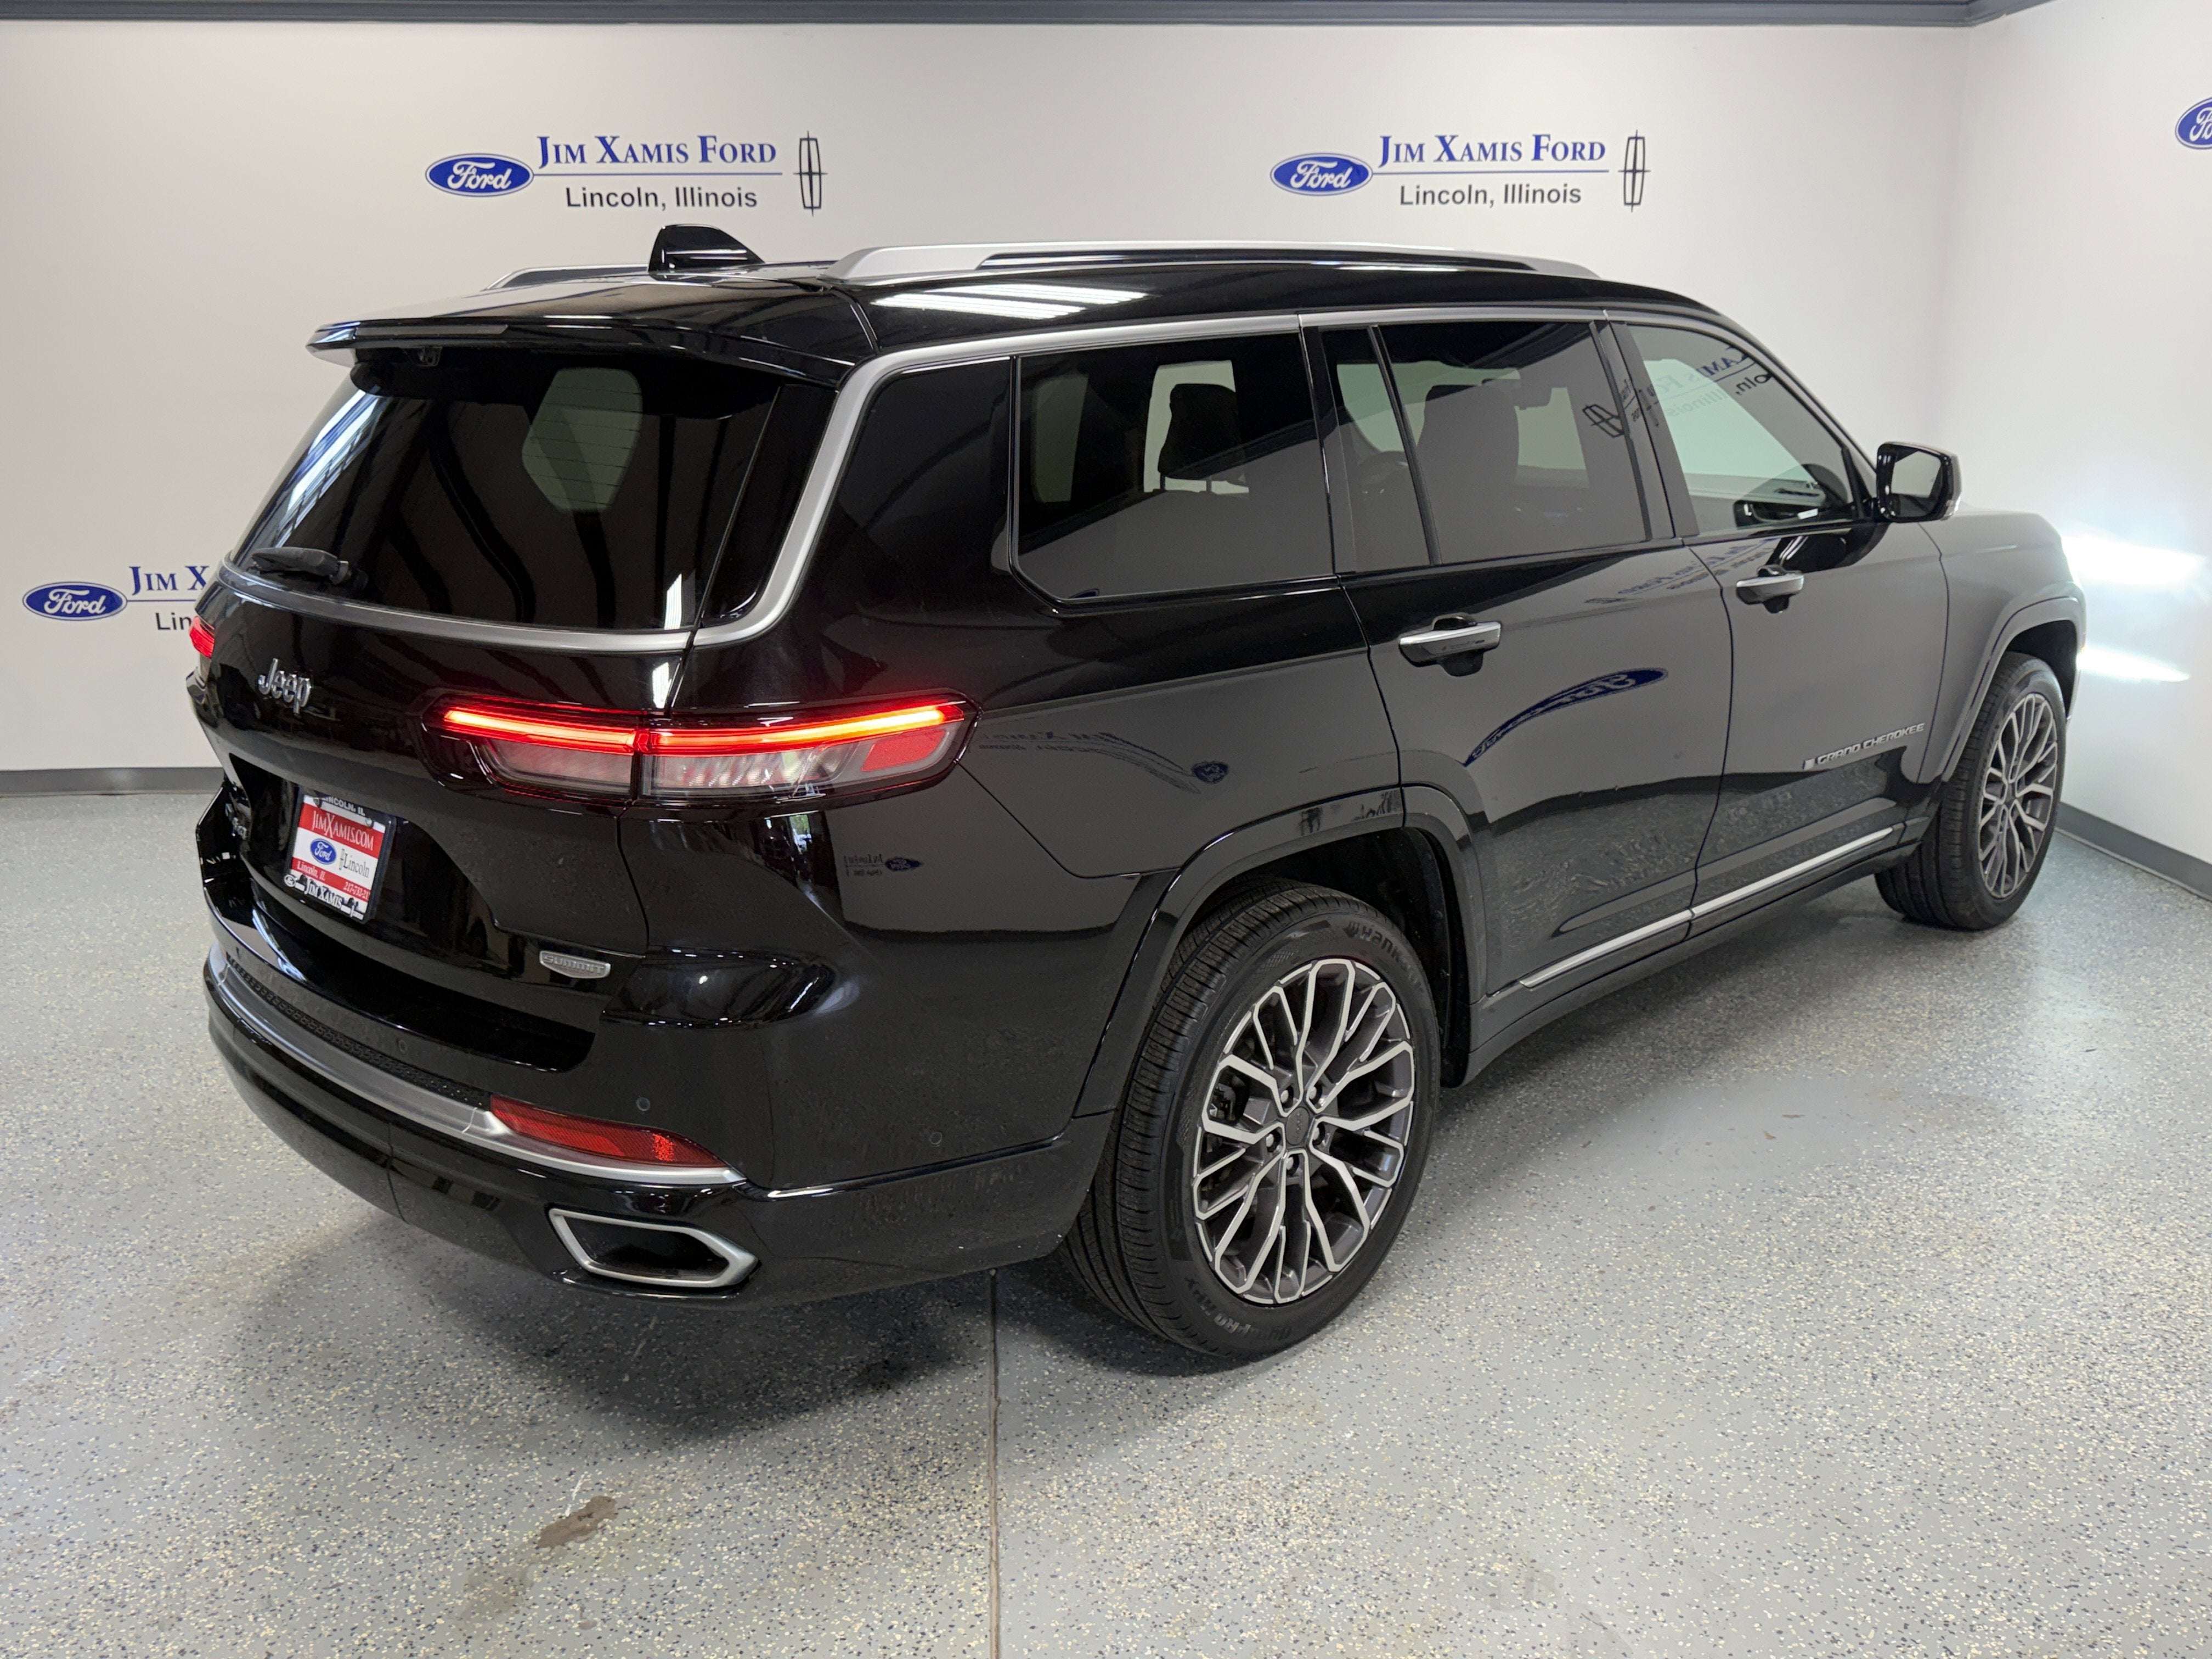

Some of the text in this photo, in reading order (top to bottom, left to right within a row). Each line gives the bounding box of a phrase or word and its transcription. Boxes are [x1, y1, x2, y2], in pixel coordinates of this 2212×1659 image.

[537, 135, 776, 168] JIM XAMIS FORD
[1378, 134, 1605, 168] JIM XAMIS FORD
[447, 160, 512, 190] Ford
[1290, 159, 1351, 189] Ford
[566, 187, 758, 210] Lincoln, Illinois
[1400, 183, 1581, 208] Lincoln, Illinois
[129, 566, 179, 595] JIM
[44, 588, 106, 614] Ford
[258, 658, 312, 716] Jeep
[1817, 723, 1926, 765] GRAND CHEROKEE
[311, 810, 374, 851] JIMXAMIS.COM
[314, 841, 331, 860] Ford
[304, 878, 319, 897] JIM
[318, 885, 343, 909] XAMIS
[544, 955, 604, 974] SUMMIT
